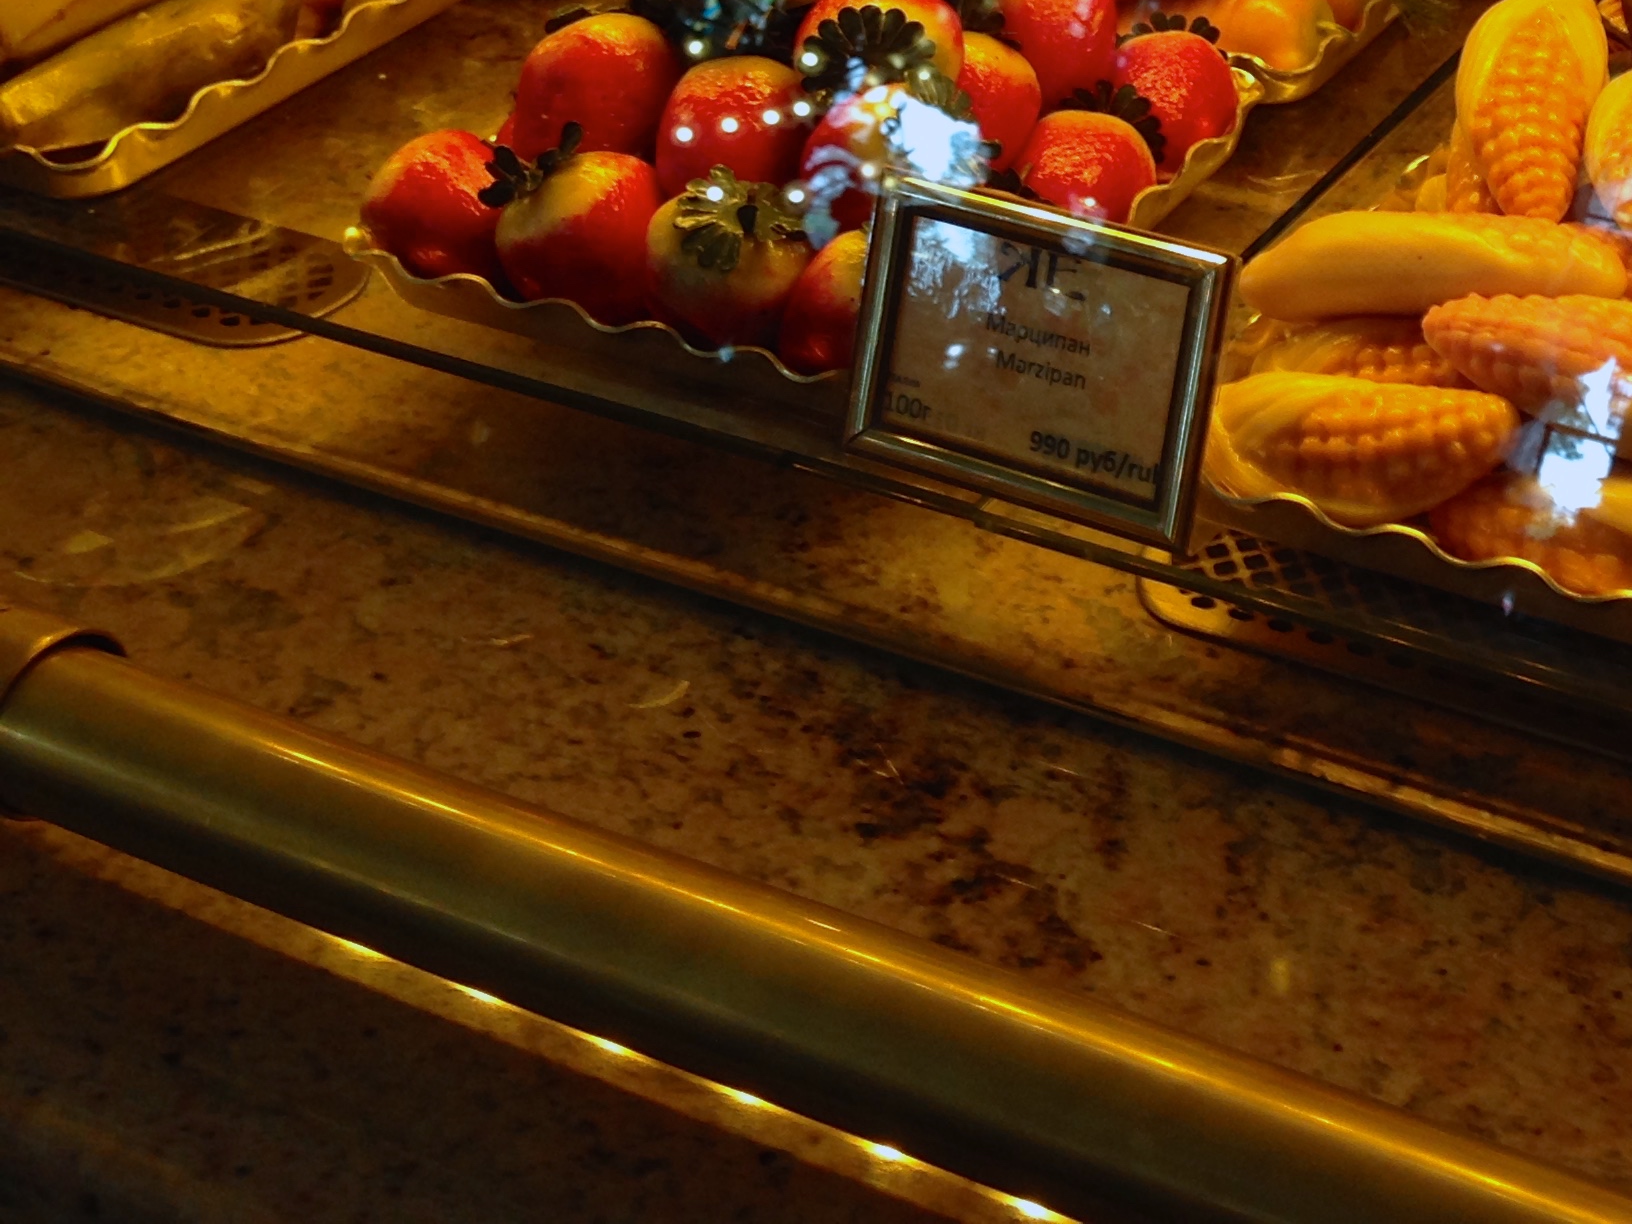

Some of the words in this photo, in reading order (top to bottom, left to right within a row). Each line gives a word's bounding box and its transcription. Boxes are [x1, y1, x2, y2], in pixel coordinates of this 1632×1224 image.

[986, 312, 1091, 357] Марципан
[995, 350, 1087, 390] Marzipan
[1029, 431, 1070, 460] 990
